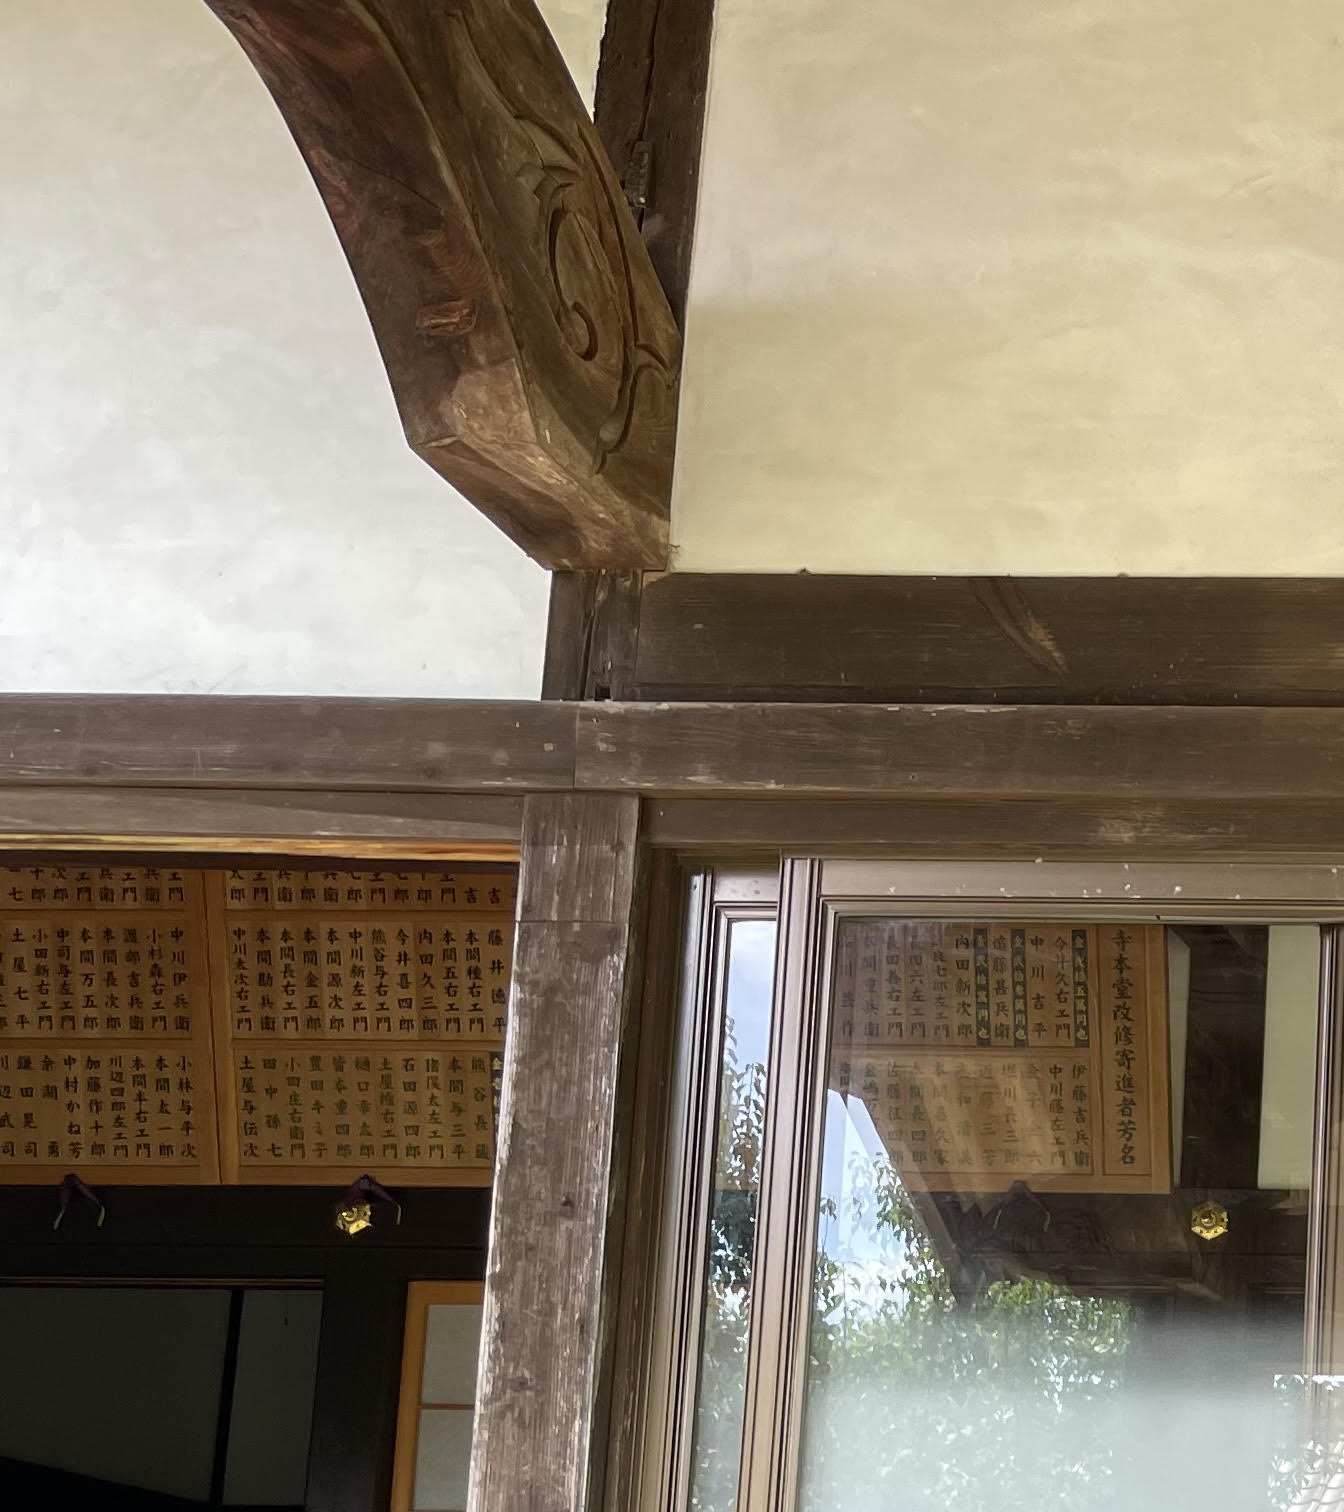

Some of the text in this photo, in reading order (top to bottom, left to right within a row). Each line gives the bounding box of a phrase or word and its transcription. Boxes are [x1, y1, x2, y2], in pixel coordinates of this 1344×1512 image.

[1110, 928, 1137, 1165] 寺本堂改修寄進者芳名
